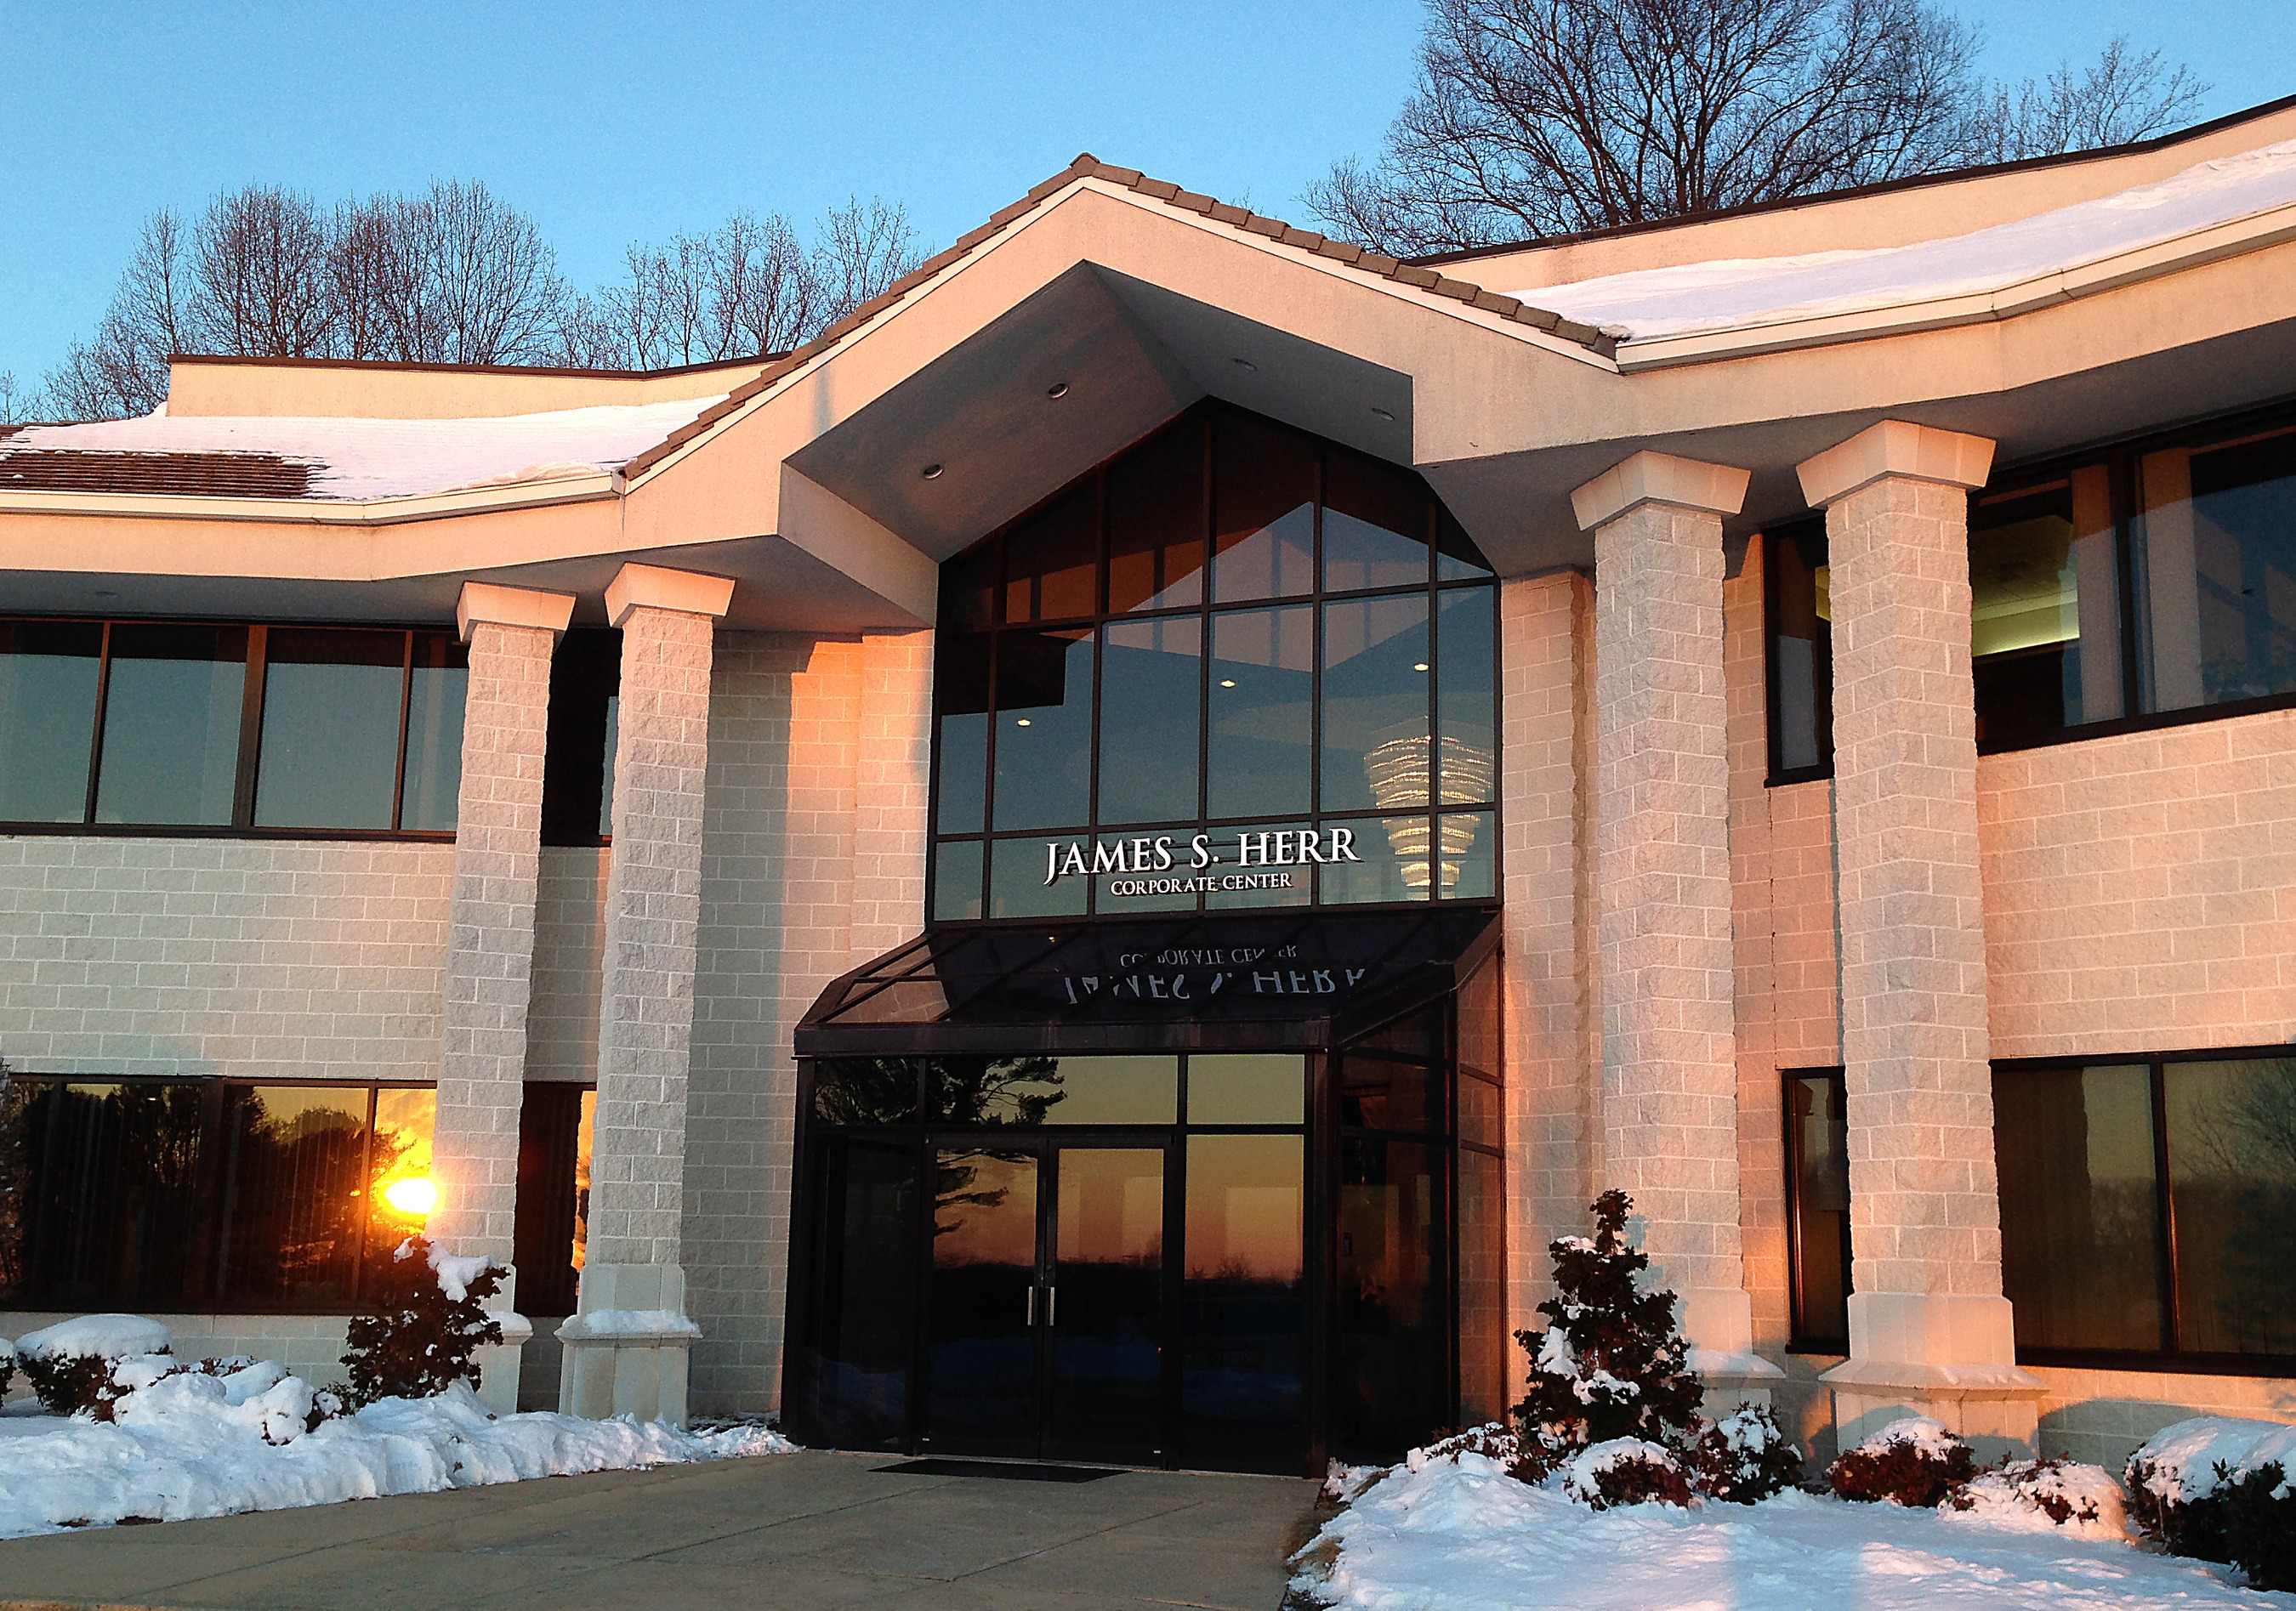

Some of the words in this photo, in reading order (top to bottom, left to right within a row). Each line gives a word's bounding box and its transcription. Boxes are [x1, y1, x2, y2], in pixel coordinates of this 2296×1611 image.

[1043, 837, 1172, 886] JAMES
[1191, 834, 1219, 869] S.
[1237, 828, 1361, 866] HERR
[1111, 876, 1219, 896] CORPORATE
[1223, 872, 1293, 890] CENTER
